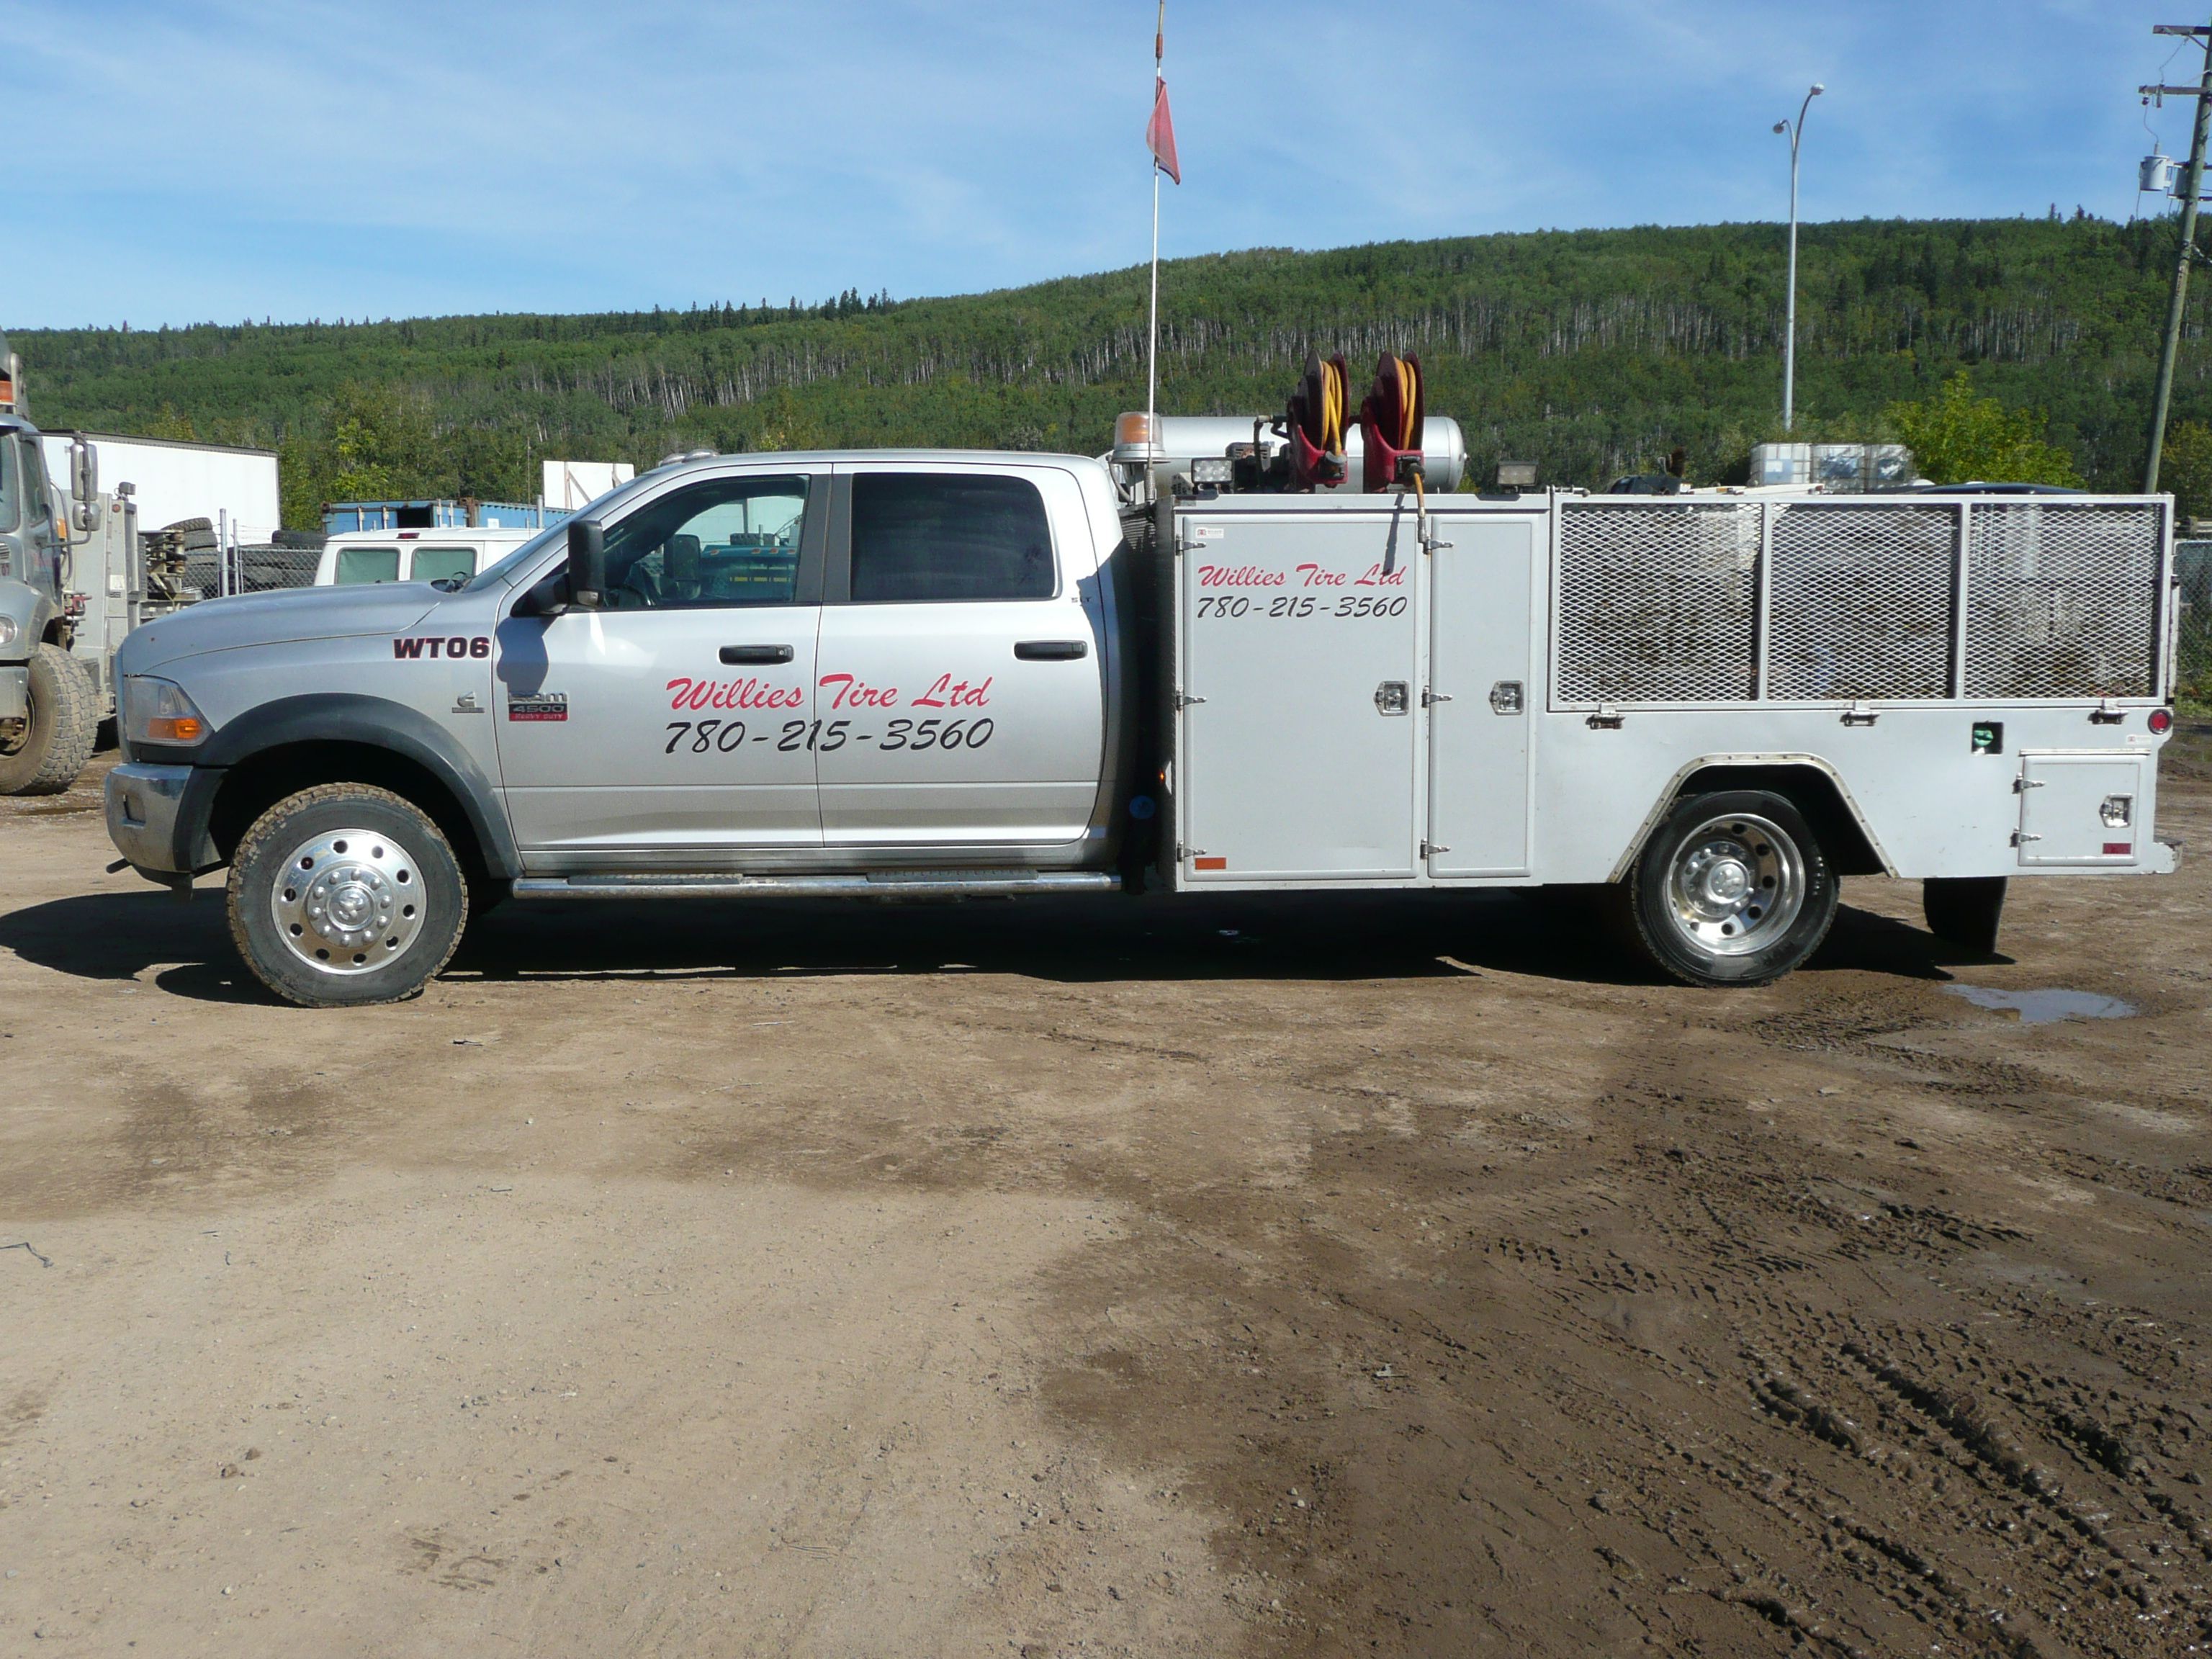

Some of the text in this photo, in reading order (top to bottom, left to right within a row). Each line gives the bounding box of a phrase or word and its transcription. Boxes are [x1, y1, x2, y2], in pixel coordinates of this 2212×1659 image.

[1197, 563, 1407, 588] Willies Tire Ltd
[1197, 595, 1408, 619] 780-215-3560
[393, 637, 490, 659] WT06
[665, 673, 993, 711] Willies Tire Ltd
[512, 704, 565, 713] 4500
[665, 718, 994, 754] 780-215-3560
